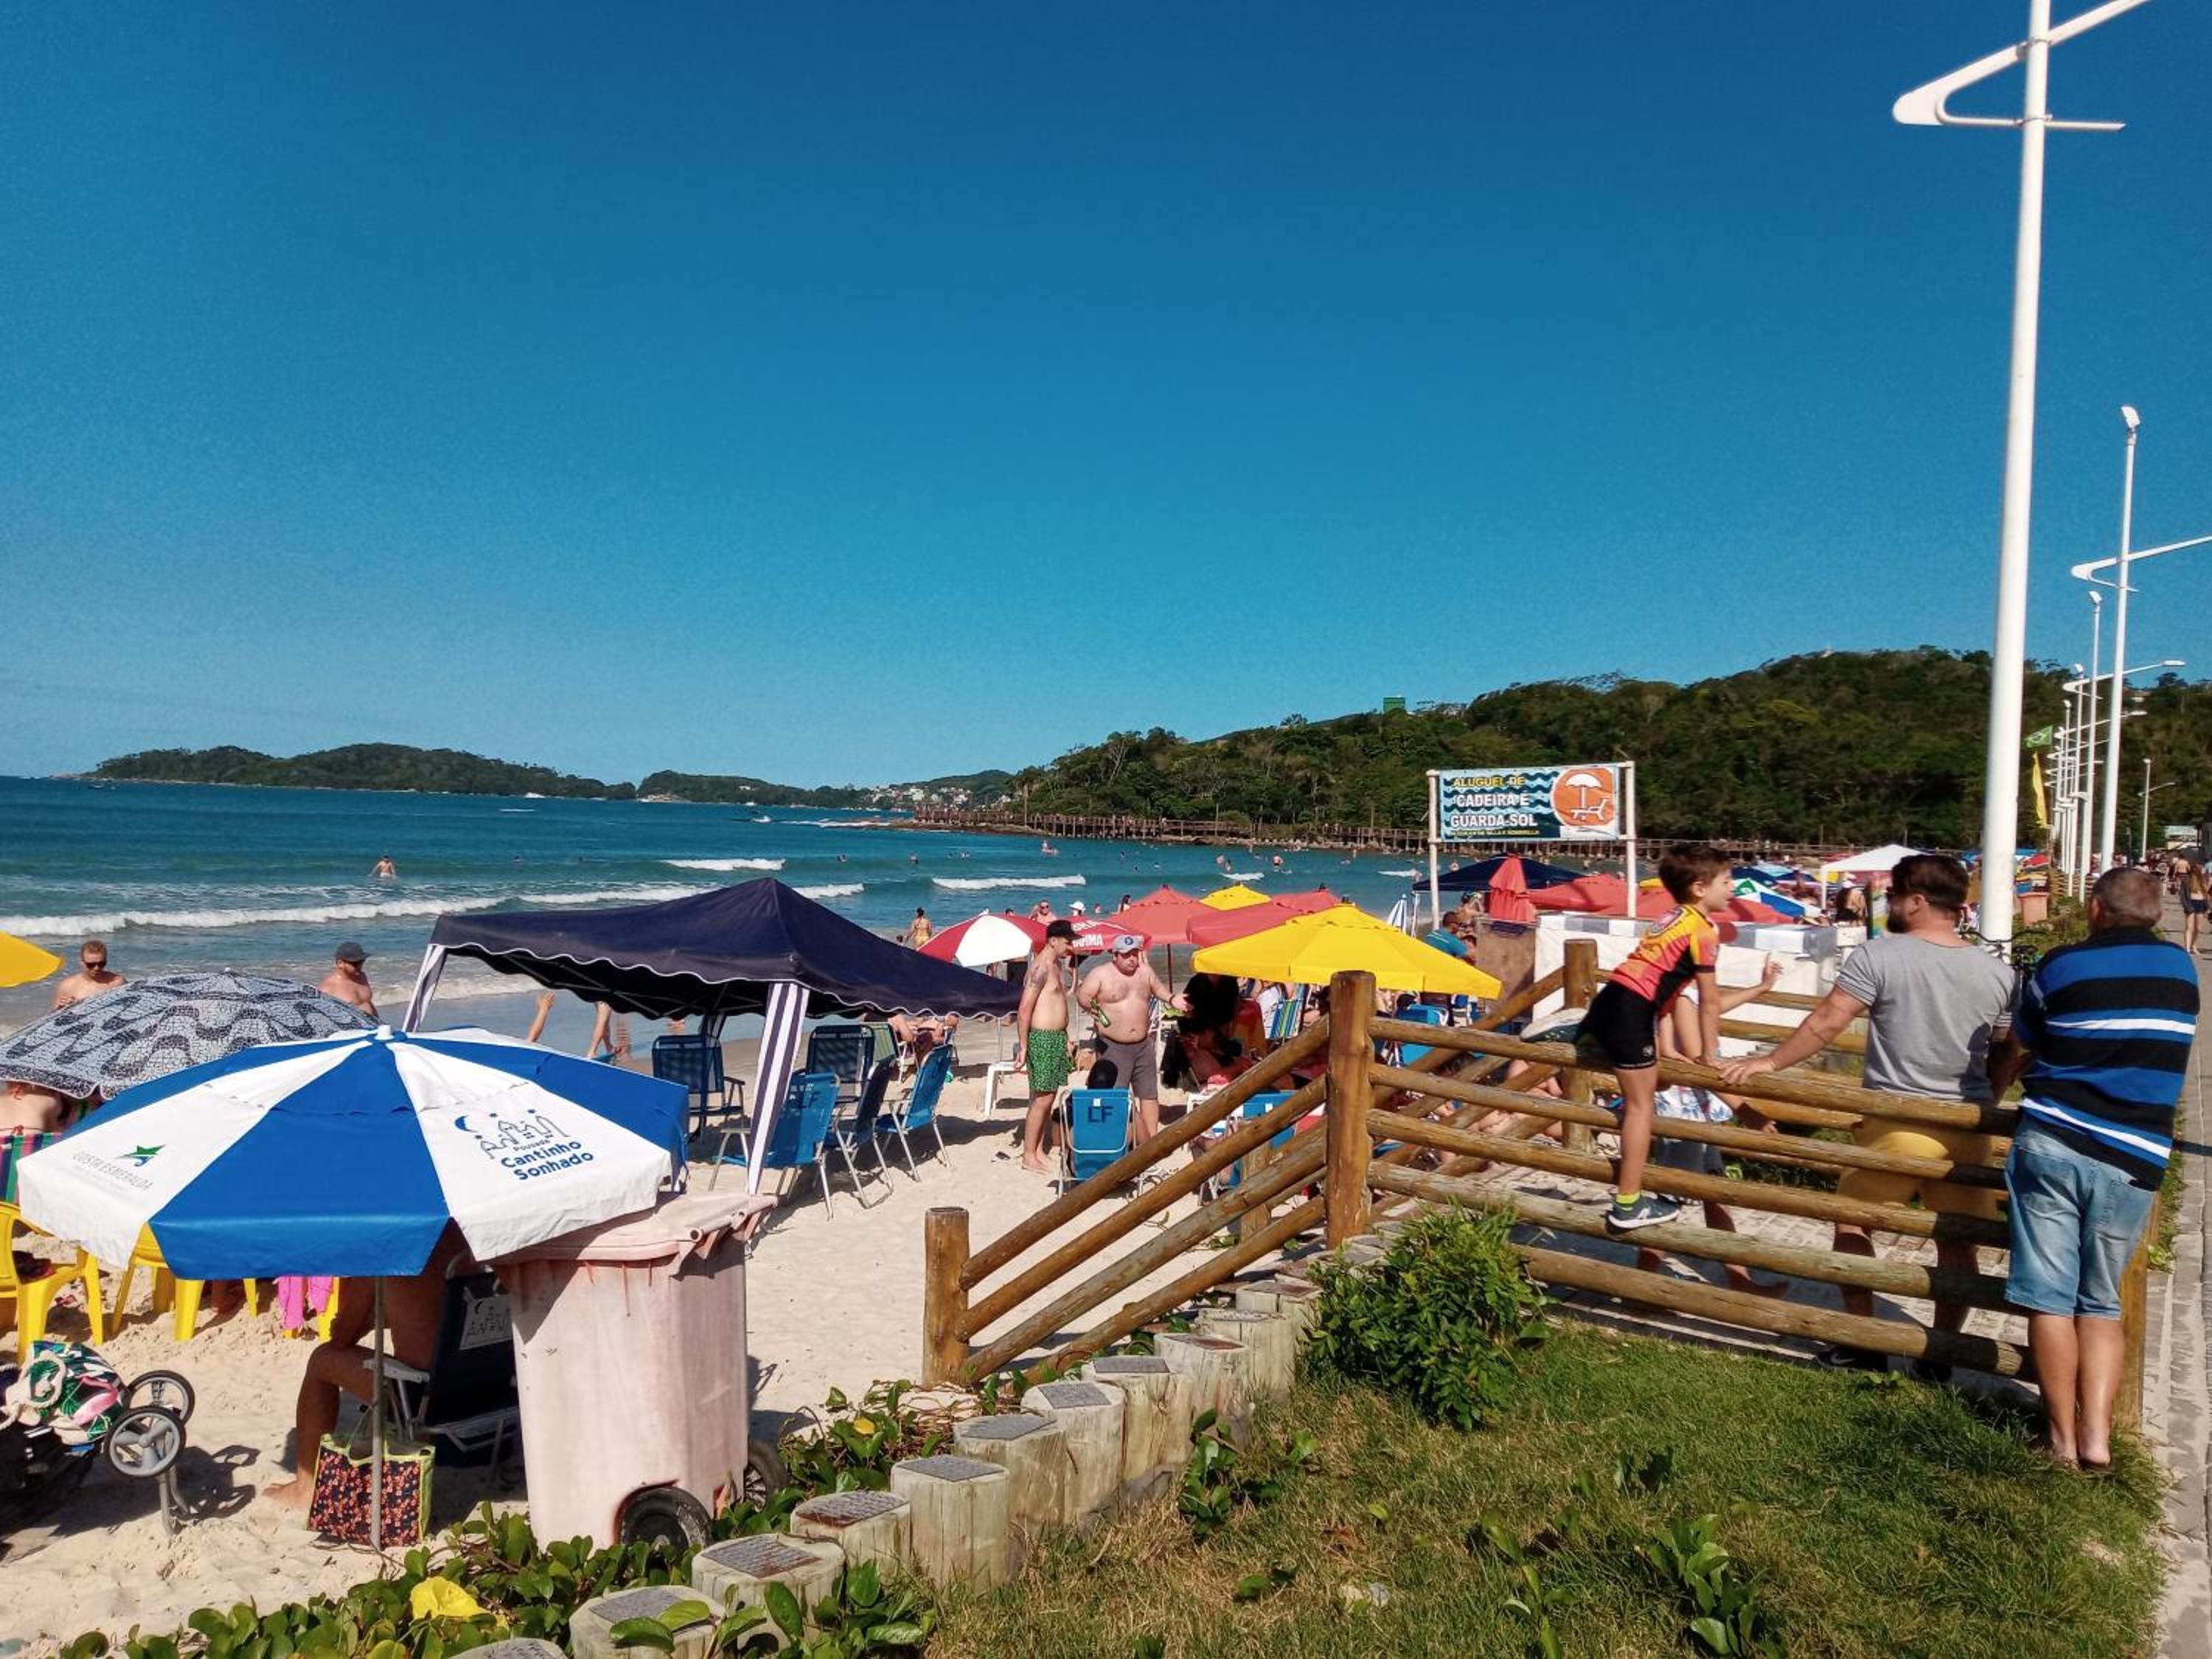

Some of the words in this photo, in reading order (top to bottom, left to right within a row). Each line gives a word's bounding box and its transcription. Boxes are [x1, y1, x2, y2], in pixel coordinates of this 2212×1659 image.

[1453, 777, 1504, 788] ALUGUEL
[1456, 793, 1515, 807] CADEIRA
[1450, 814, 1538, 827] GUARDA-SOL
[1088, 1106, 1113, 1123] LF
[501, 1140, 582, 1168] Cantinho
[513, 1152, 594, 1180] Sonhado
